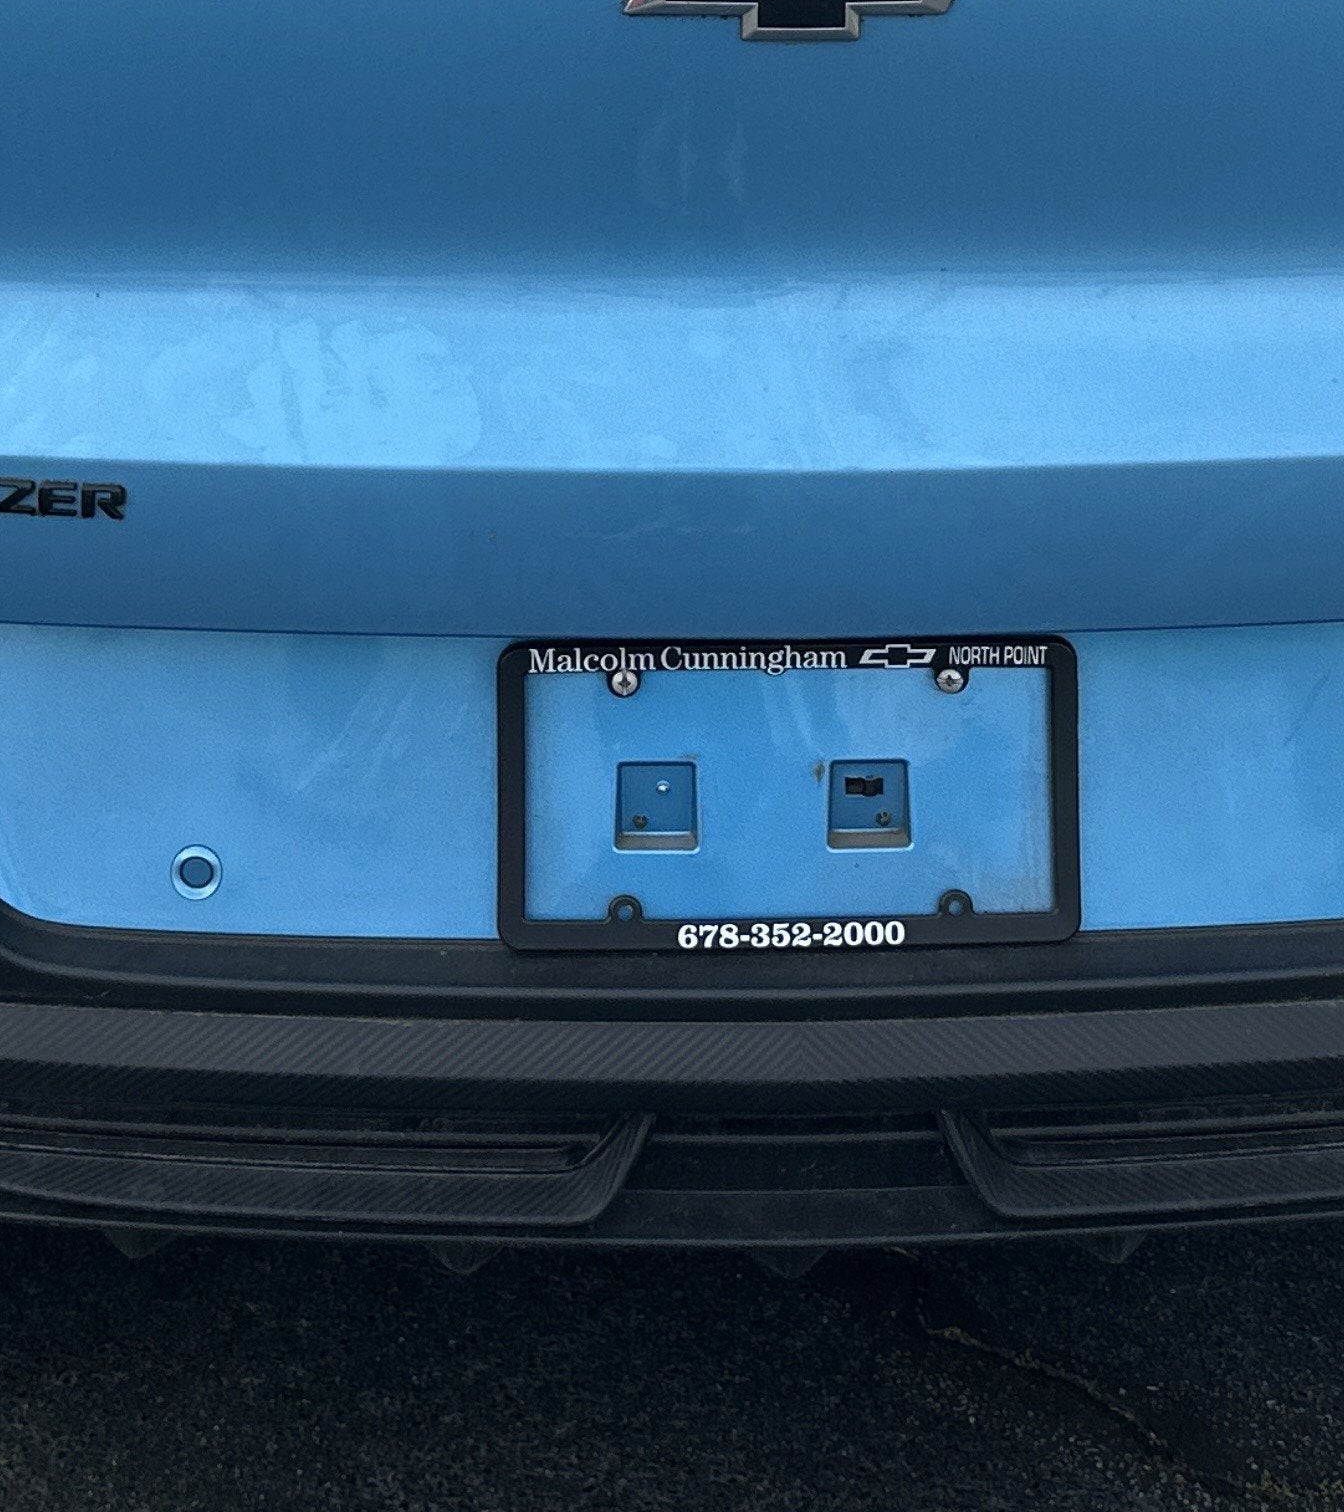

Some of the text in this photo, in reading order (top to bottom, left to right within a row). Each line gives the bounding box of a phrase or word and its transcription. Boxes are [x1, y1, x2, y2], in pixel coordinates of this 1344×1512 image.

[528, 644, 1049, 675] Malcolm Cunningham NORTH POINT
[676, 920, 907, 950] 678-352-2000
